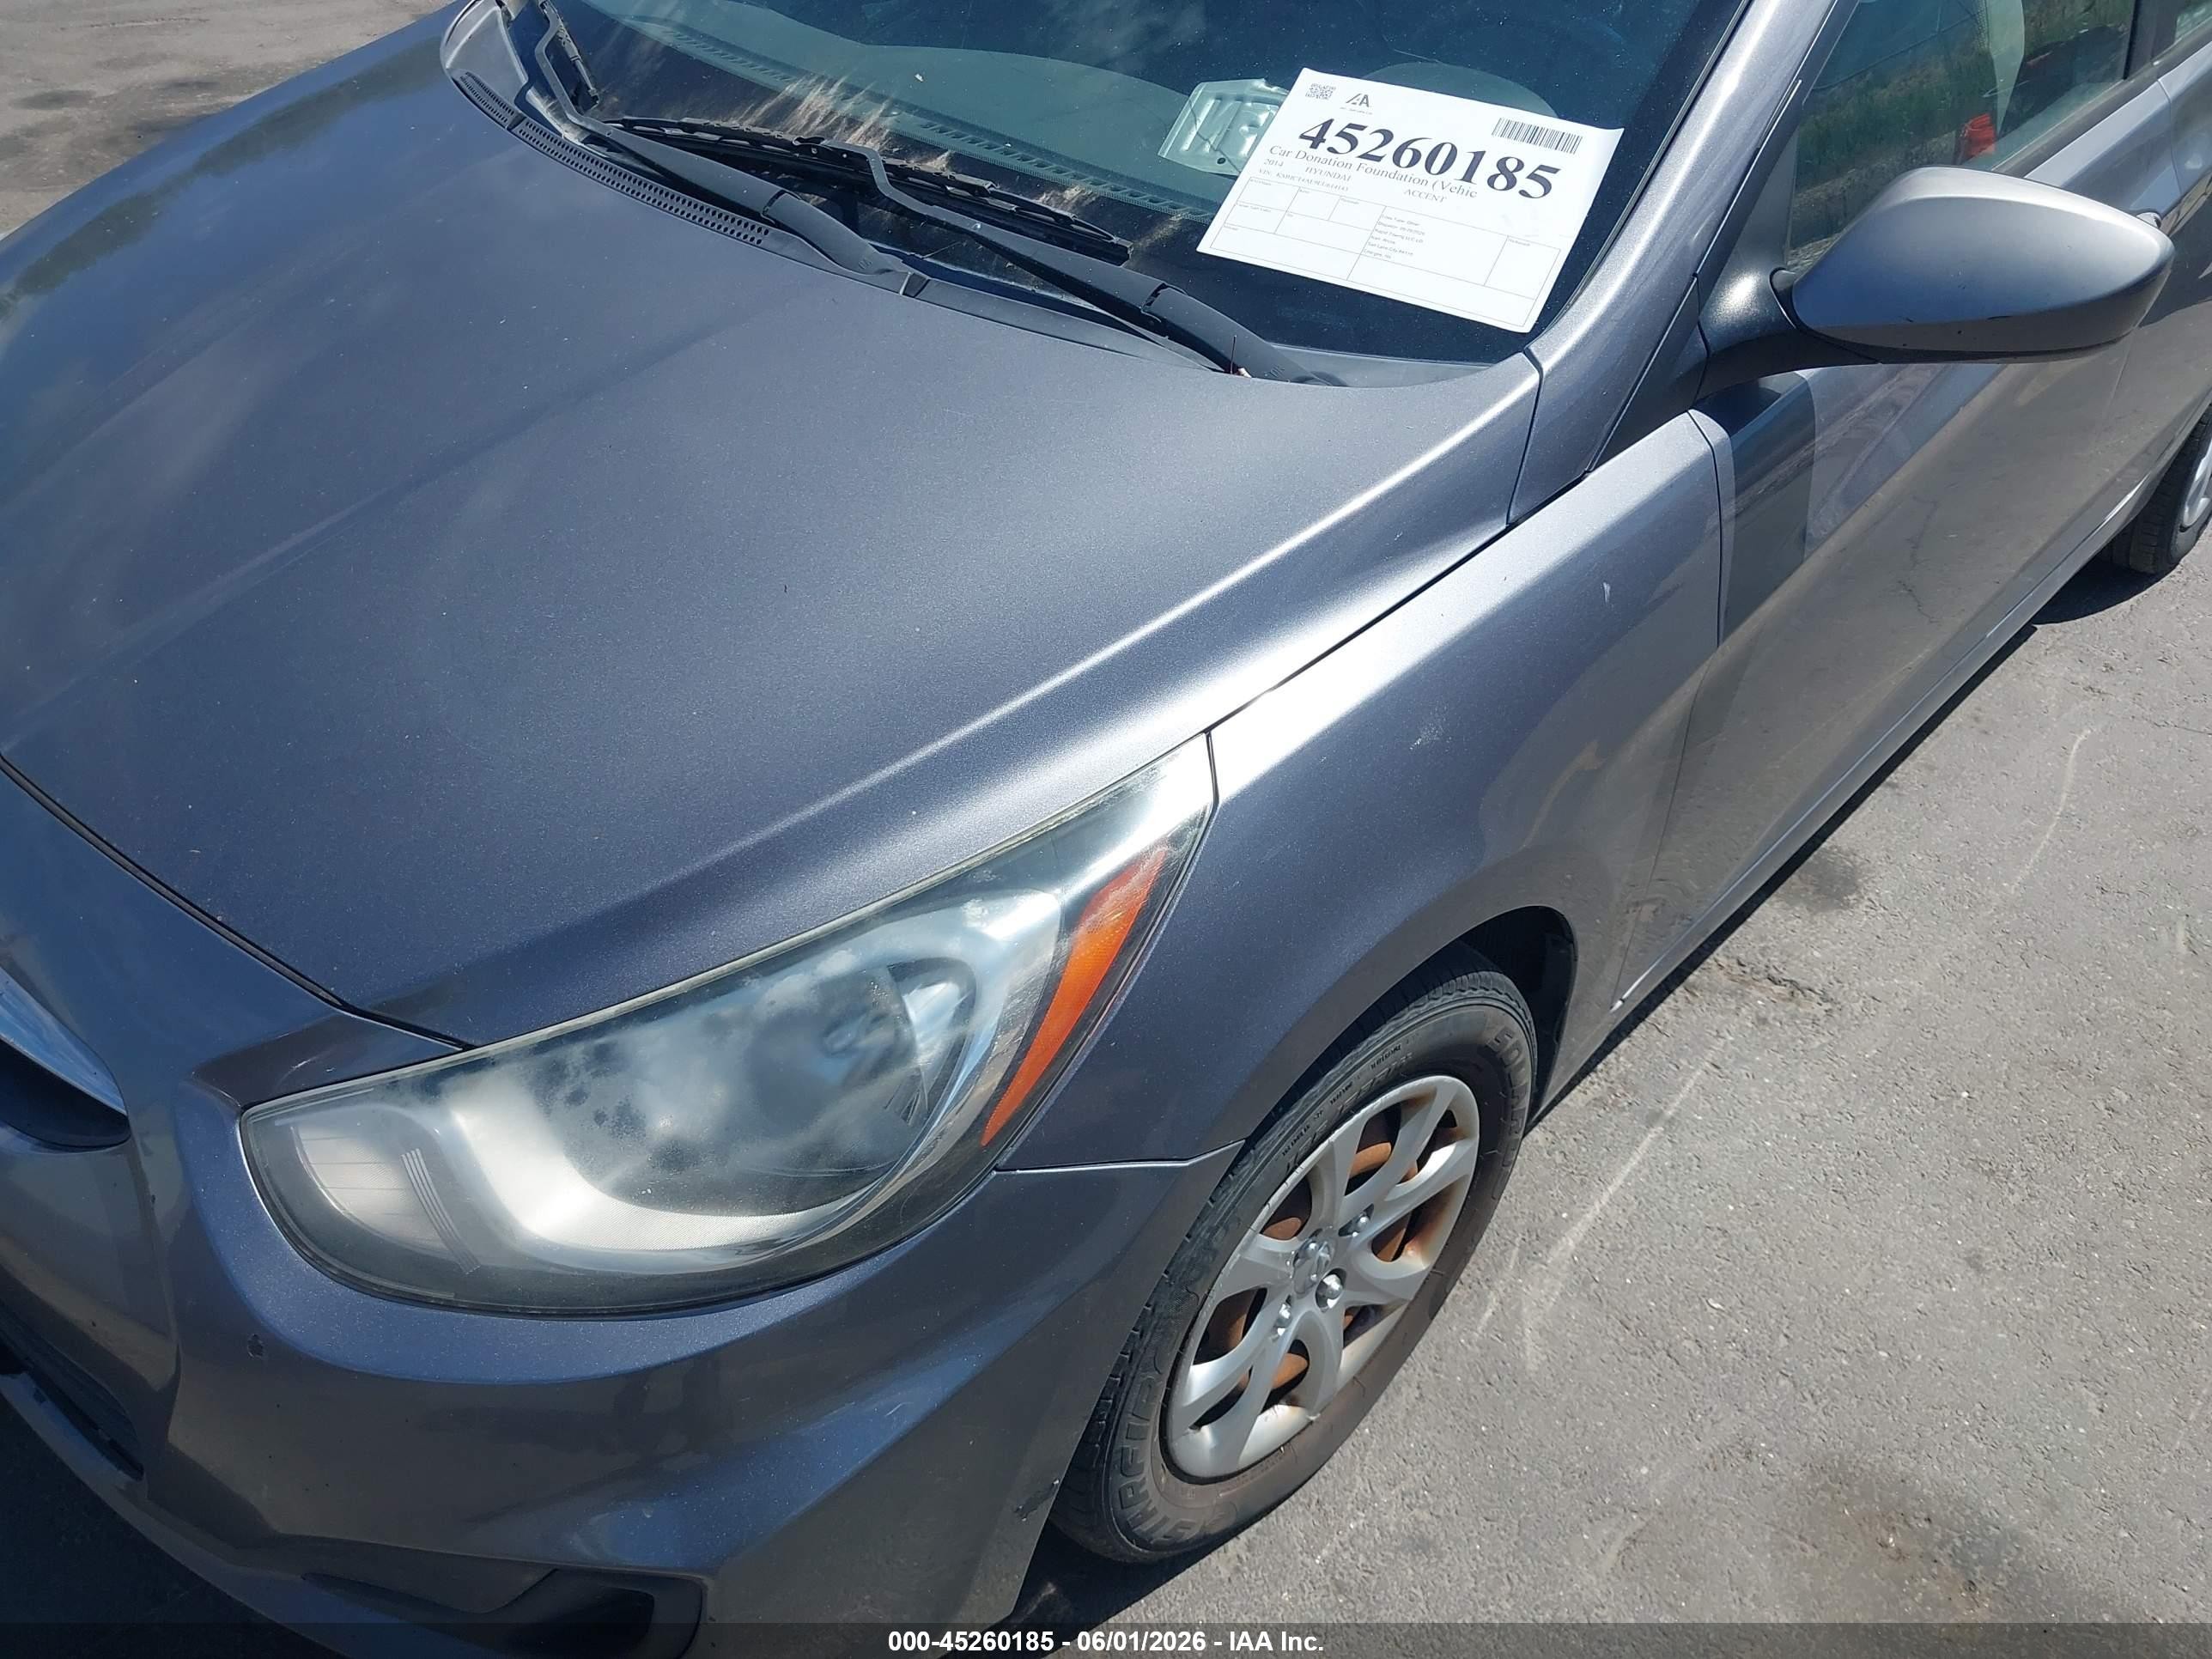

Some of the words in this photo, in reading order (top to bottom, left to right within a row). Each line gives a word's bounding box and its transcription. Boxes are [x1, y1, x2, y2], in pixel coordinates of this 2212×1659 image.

[1264, 158, 1285, 167] 2014
[1304, 167, 1352, 182] HYUNDAI
[1403, 188, 1448, 203] ACCENT
[1270, 145, 1293, 156] Car
[1295, 149, 1353, 171] Donation
[1357, 162, 1429, 186] Foundation
[1431, 179, 1477, 198] (Vehic
[1298, 118, 1562, 199] 45260185
